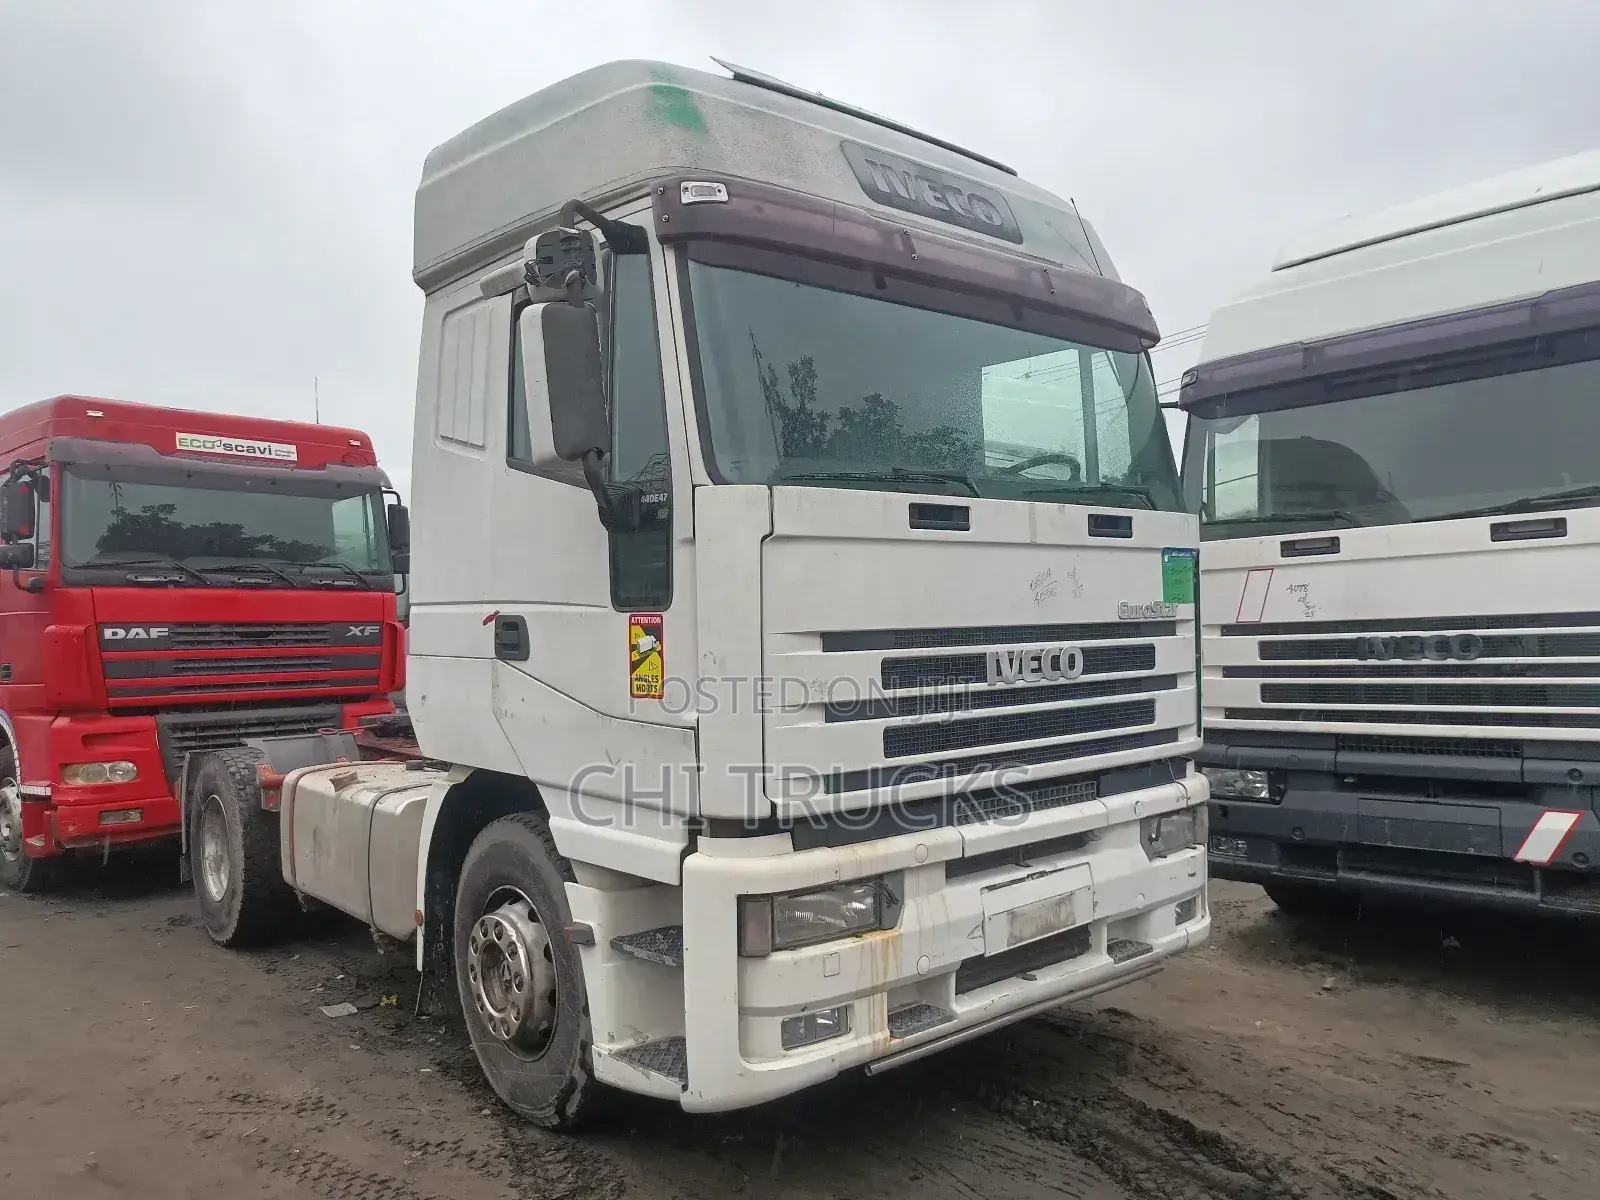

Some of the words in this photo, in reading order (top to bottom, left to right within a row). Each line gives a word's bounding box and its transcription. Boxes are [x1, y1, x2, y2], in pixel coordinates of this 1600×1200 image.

[864, 157, 1004, 228] IVECO
[630, 616, 662, 624] ATTENTION
[103, 627, 169, 640] DAF
[345, 625, 380, 637] XF
[1356, 633, 1483, 661] IVECO
[986, 645, 1084, 686] IVECO
[634, 673, 659, 683] ANGLES
[635, 683, 658, 693] MORTS
